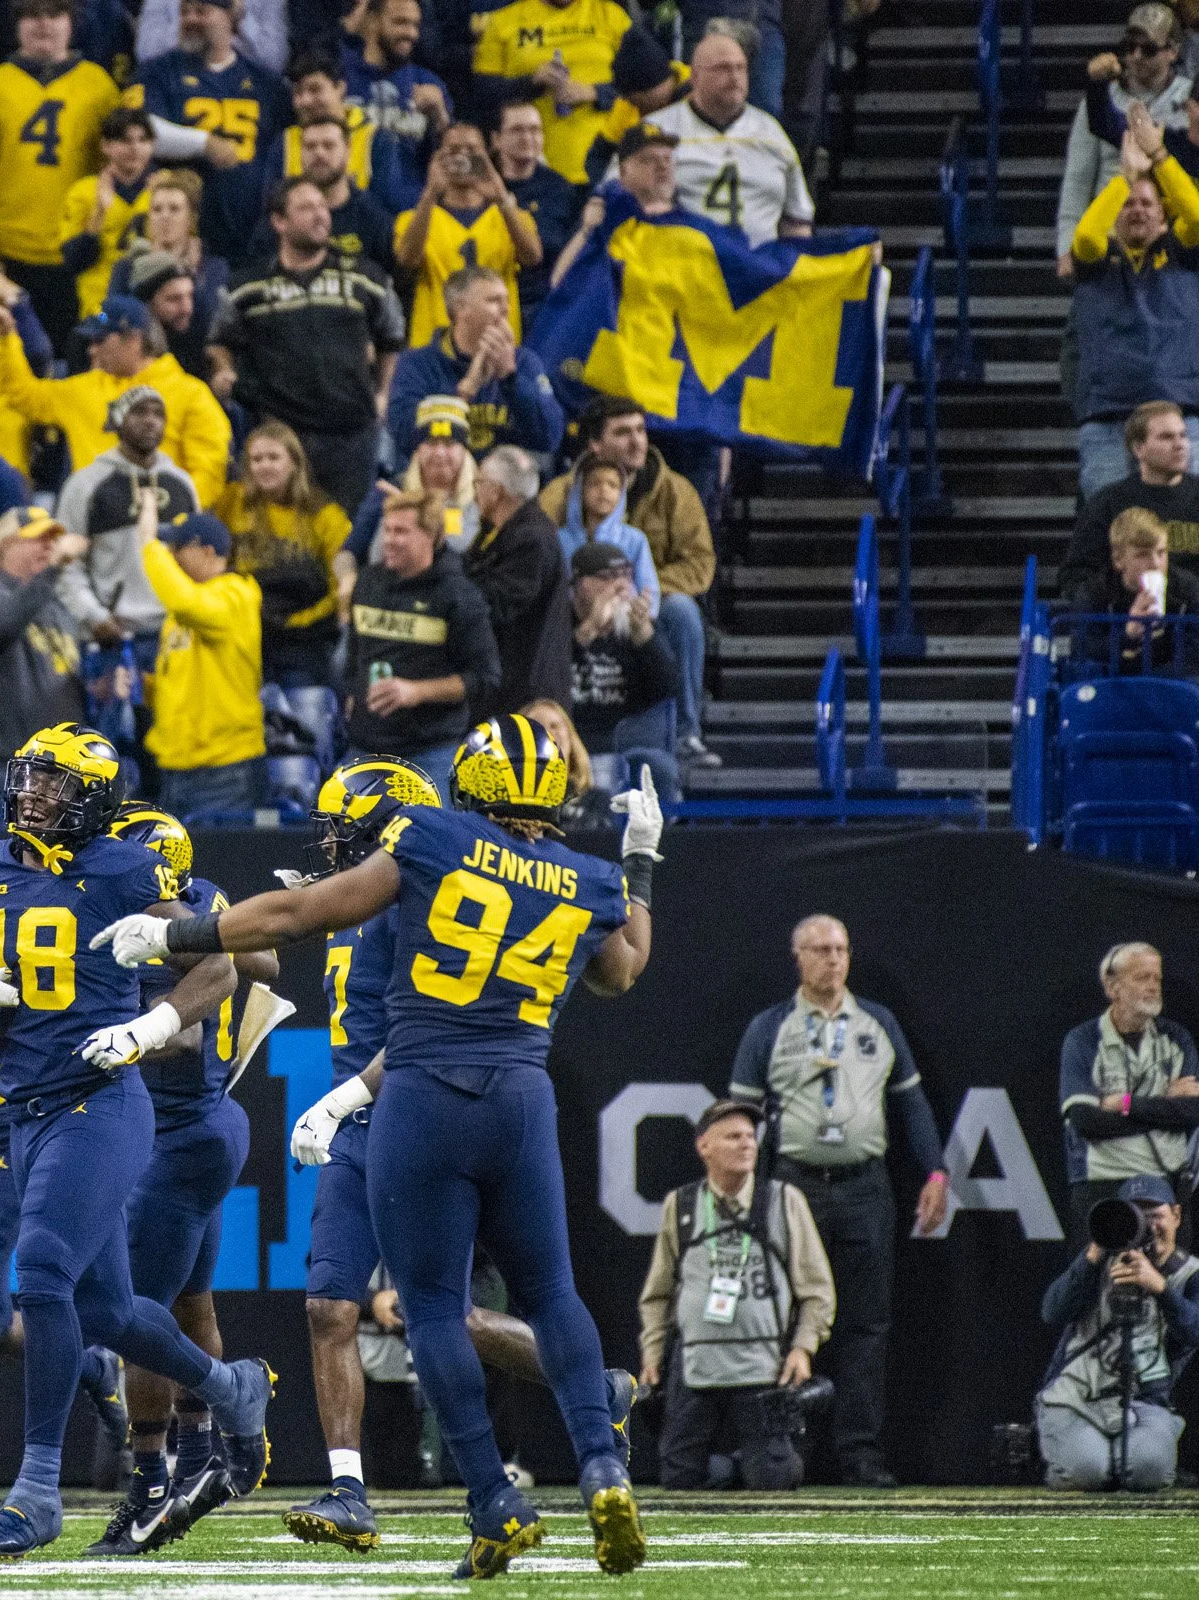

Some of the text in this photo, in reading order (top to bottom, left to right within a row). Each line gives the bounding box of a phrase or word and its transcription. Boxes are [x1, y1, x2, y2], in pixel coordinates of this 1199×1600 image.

[19, 99, 65, 166] 4
[184, 97, 260, 163] 25
[704, 162, 743, 228] 4
[583, 215, 872, 449] M
[379, 815, 413, 854] 4
[463, 838, 579, 901] JENKINS
[410, 868, 593, 1028] 94
[599, 1082, 1065, 1240] CA
